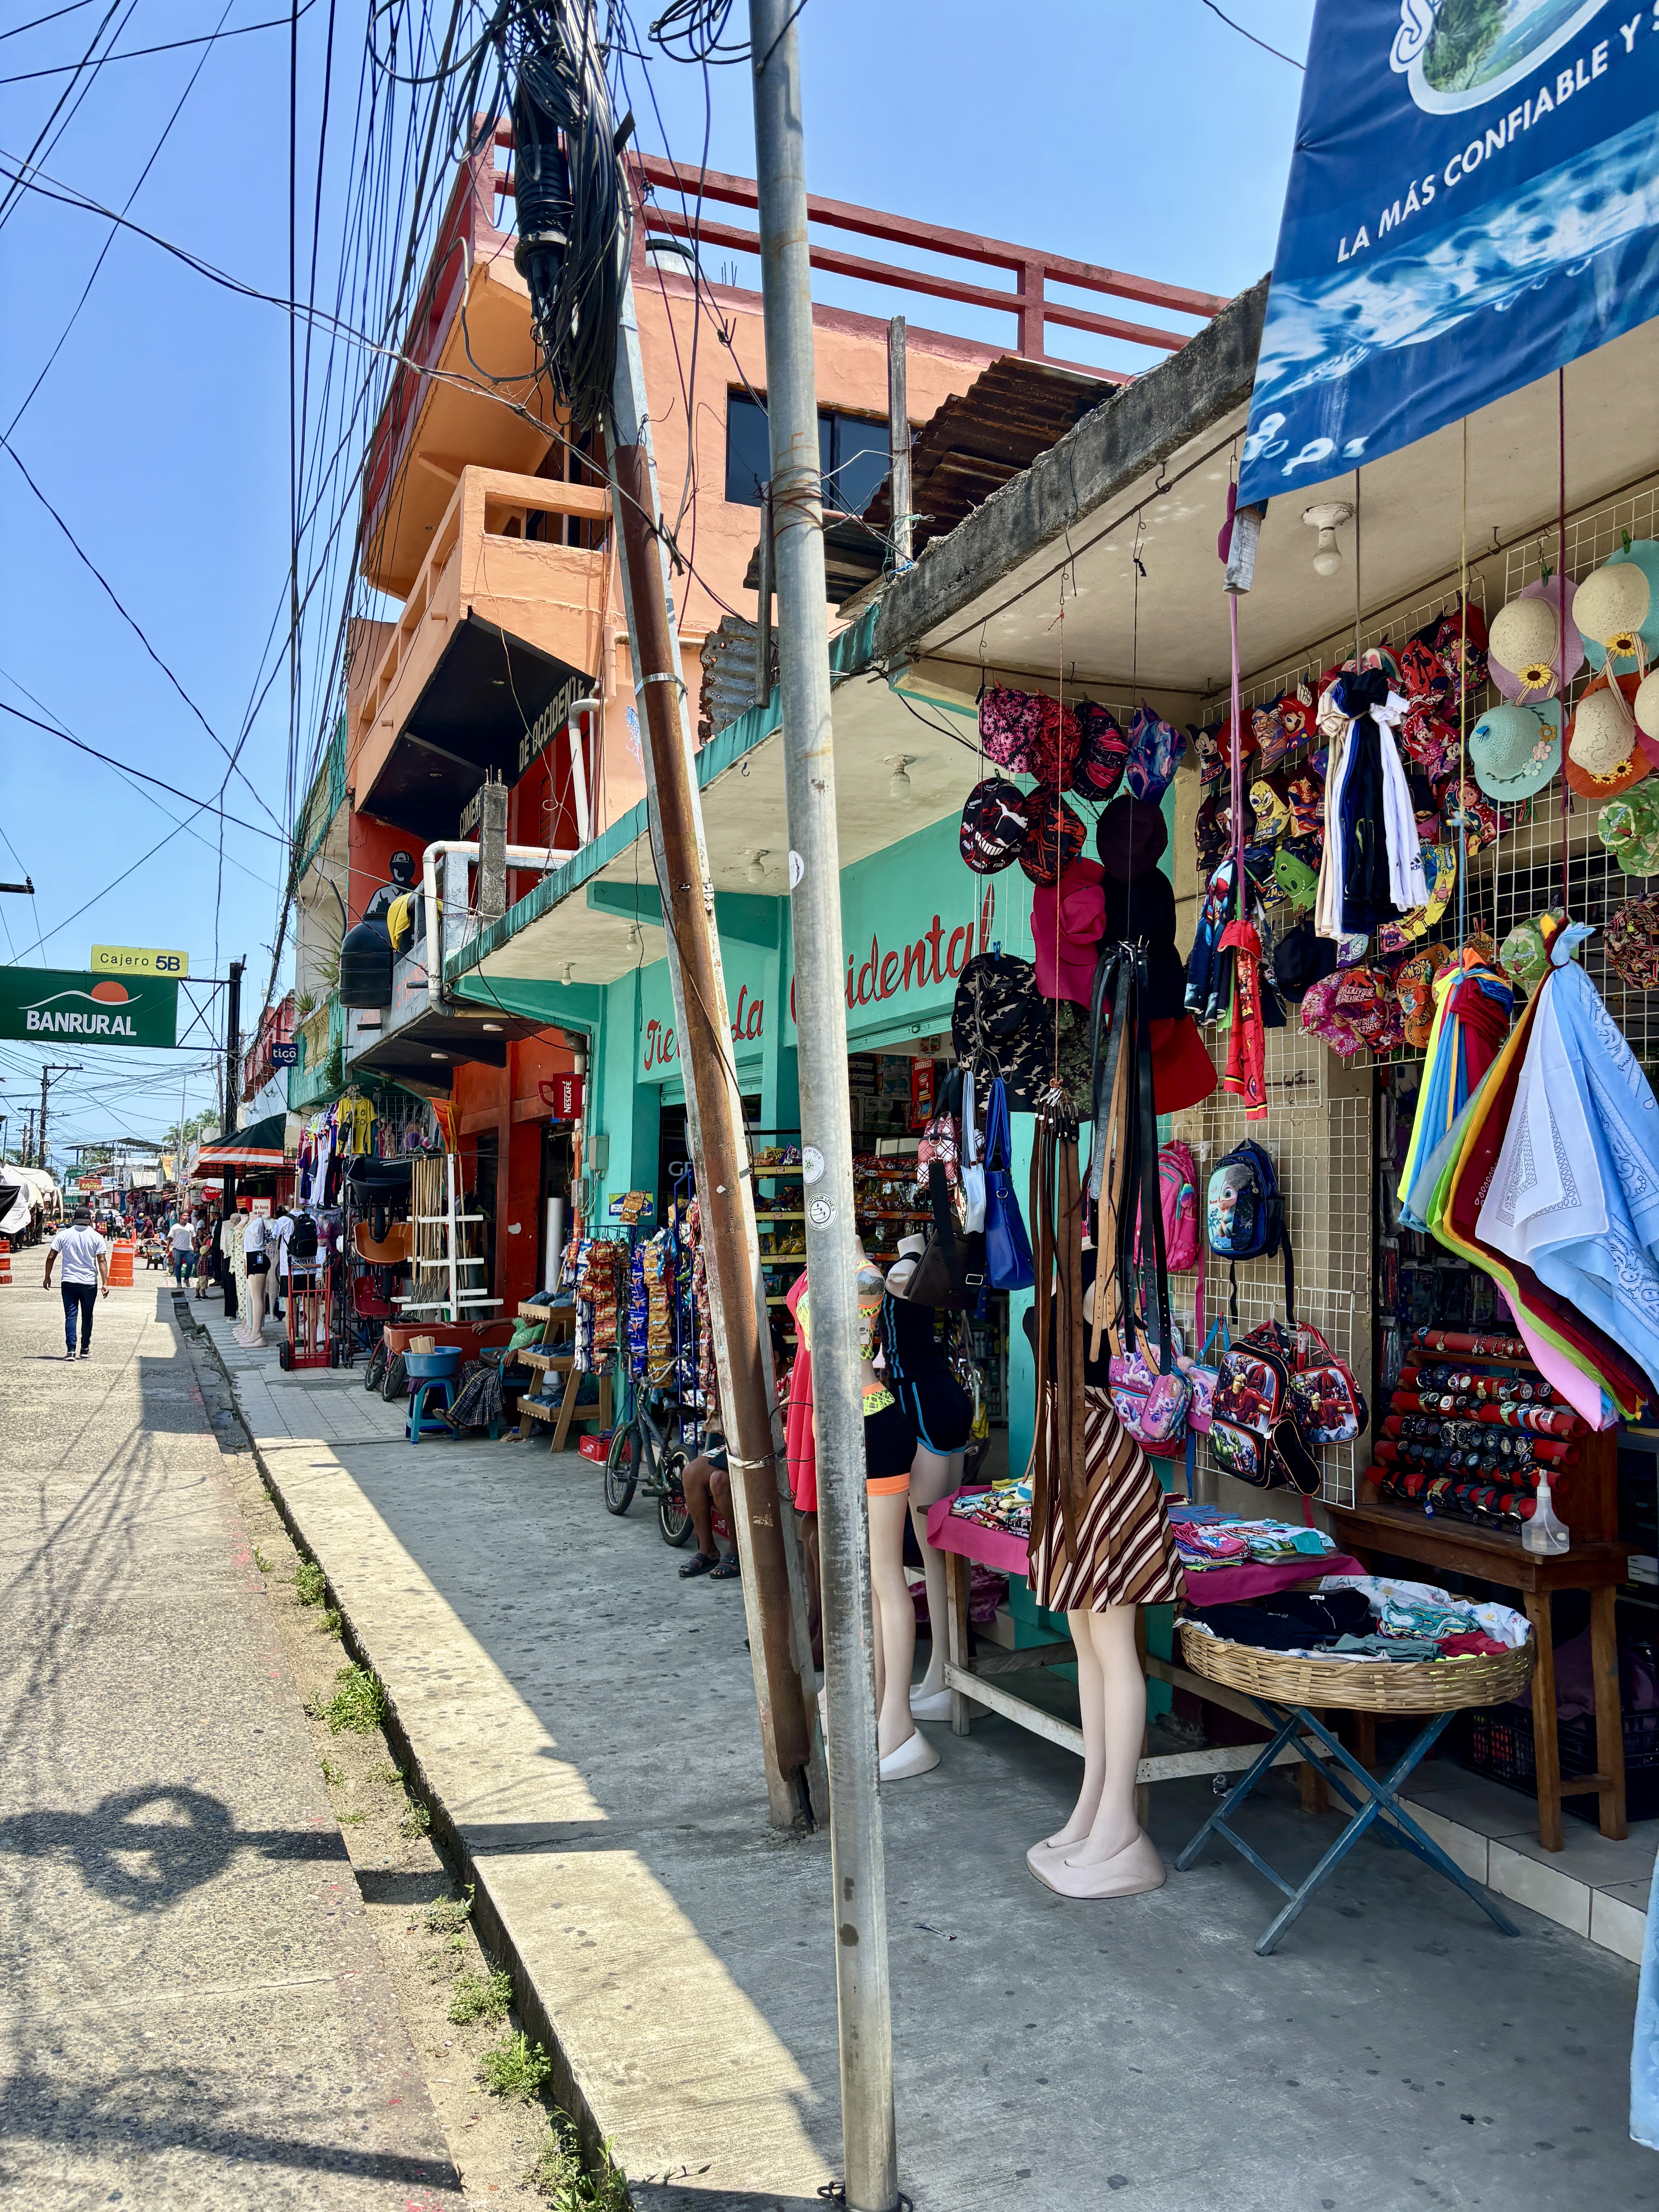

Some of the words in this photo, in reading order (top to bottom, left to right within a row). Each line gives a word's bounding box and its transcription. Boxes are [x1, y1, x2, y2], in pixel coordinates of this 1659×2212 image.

[1337, 225, 1370, 263] LA
[1378, 173, 1435, 239] MÁS
[1444, 40, 1608, 187] CONFIABLE
[1619, 12, 1642, 53] Y
[519, 732, 529, 773] DE
[100, 953, 149, 967] Cajero
[155, 955, 180, 971] 5B
[26, 1010, 137, 1036] BANRURAL
[731, 984, 764, 1043] La
[562, 1080, 572, 1113] NESCAFÉ
